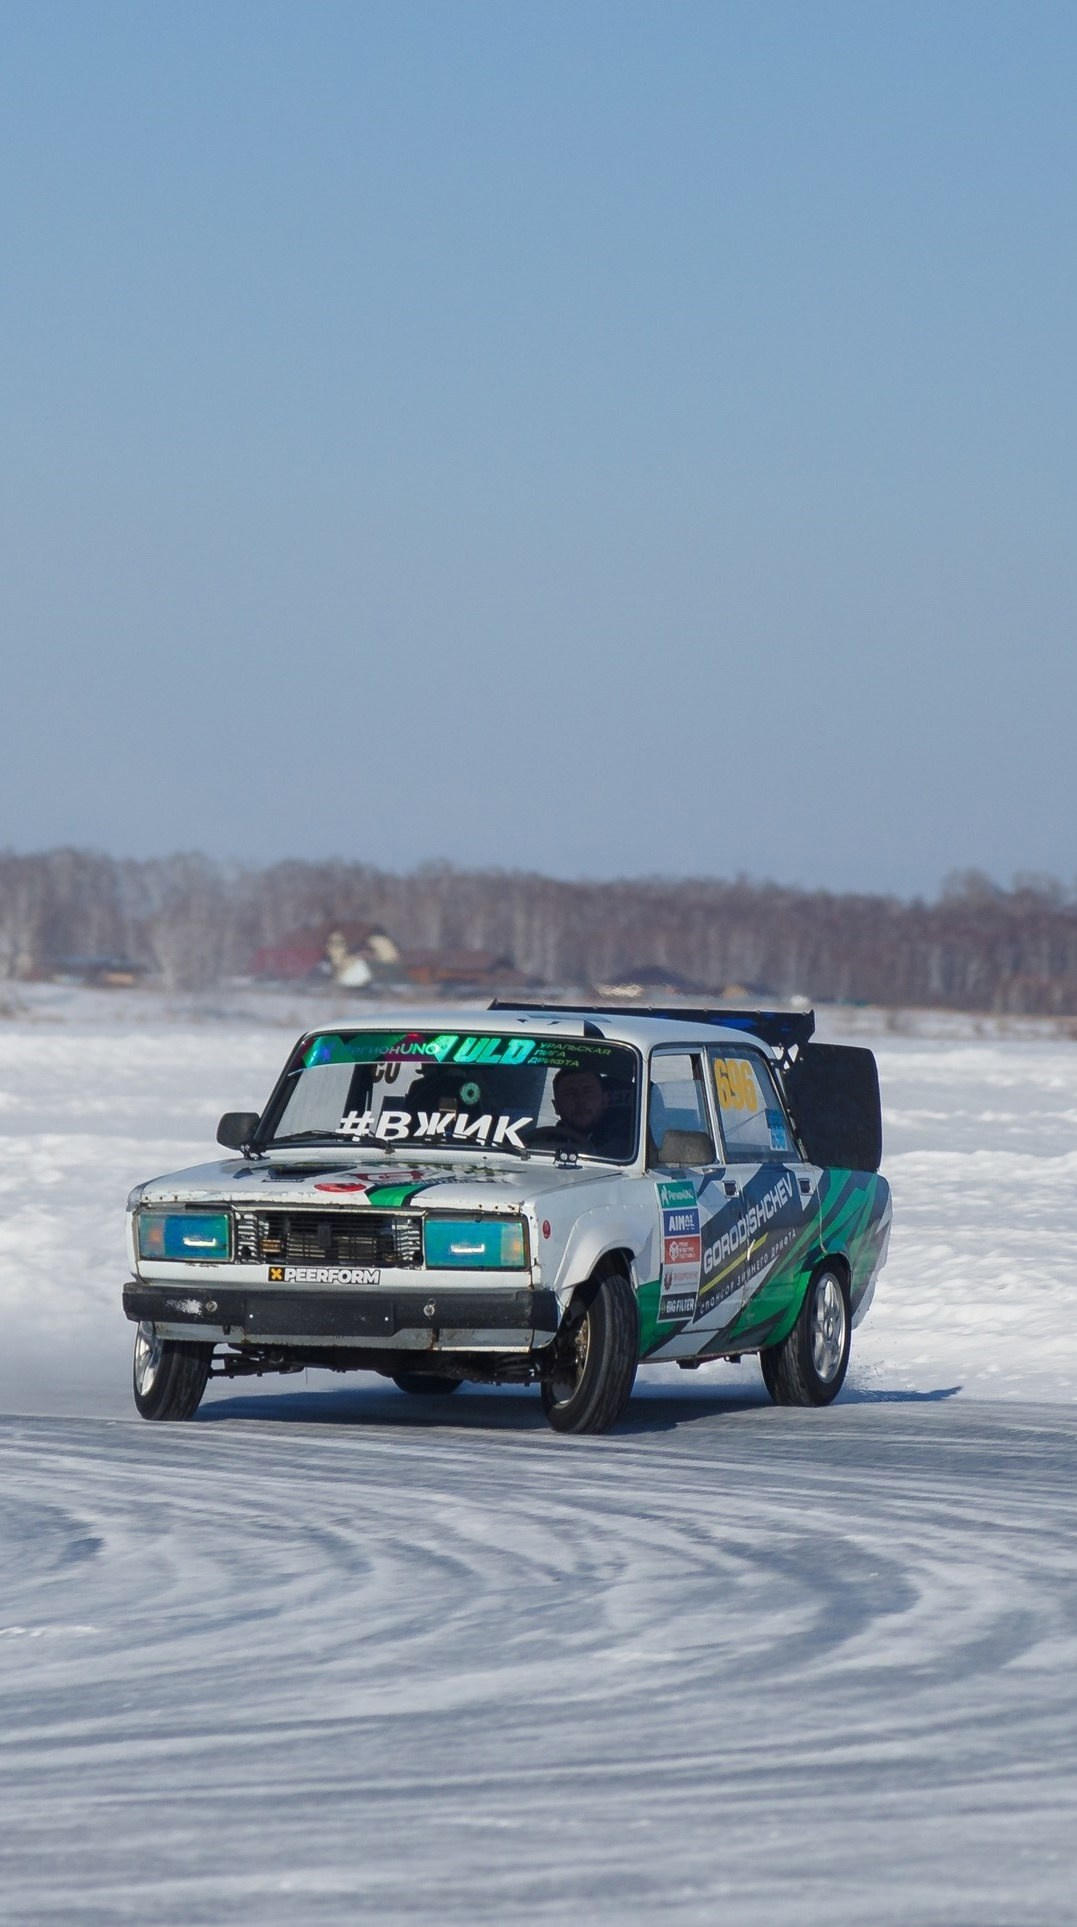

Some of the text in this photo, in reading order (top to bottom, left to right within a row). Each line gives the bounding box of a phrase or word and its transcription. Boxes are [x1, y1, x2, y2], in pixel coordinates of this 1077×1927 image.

[534, 1049, 566, 1057] ЛИГА
[539, 1042, 612, 1056] УРАЛЬСКАЯ
[527, 1057, 580, 1067] ДРИФТА
[713, 1057, 758, 1112] 696
[336, 1110, 533, 1149] #ВЖИК
[703, 1173, 793, 1275] GORODISHCHEV
[284, 1267, 380, 1285] PEERFORM
[666, 1298, 695, 1313] BIG FILTER
